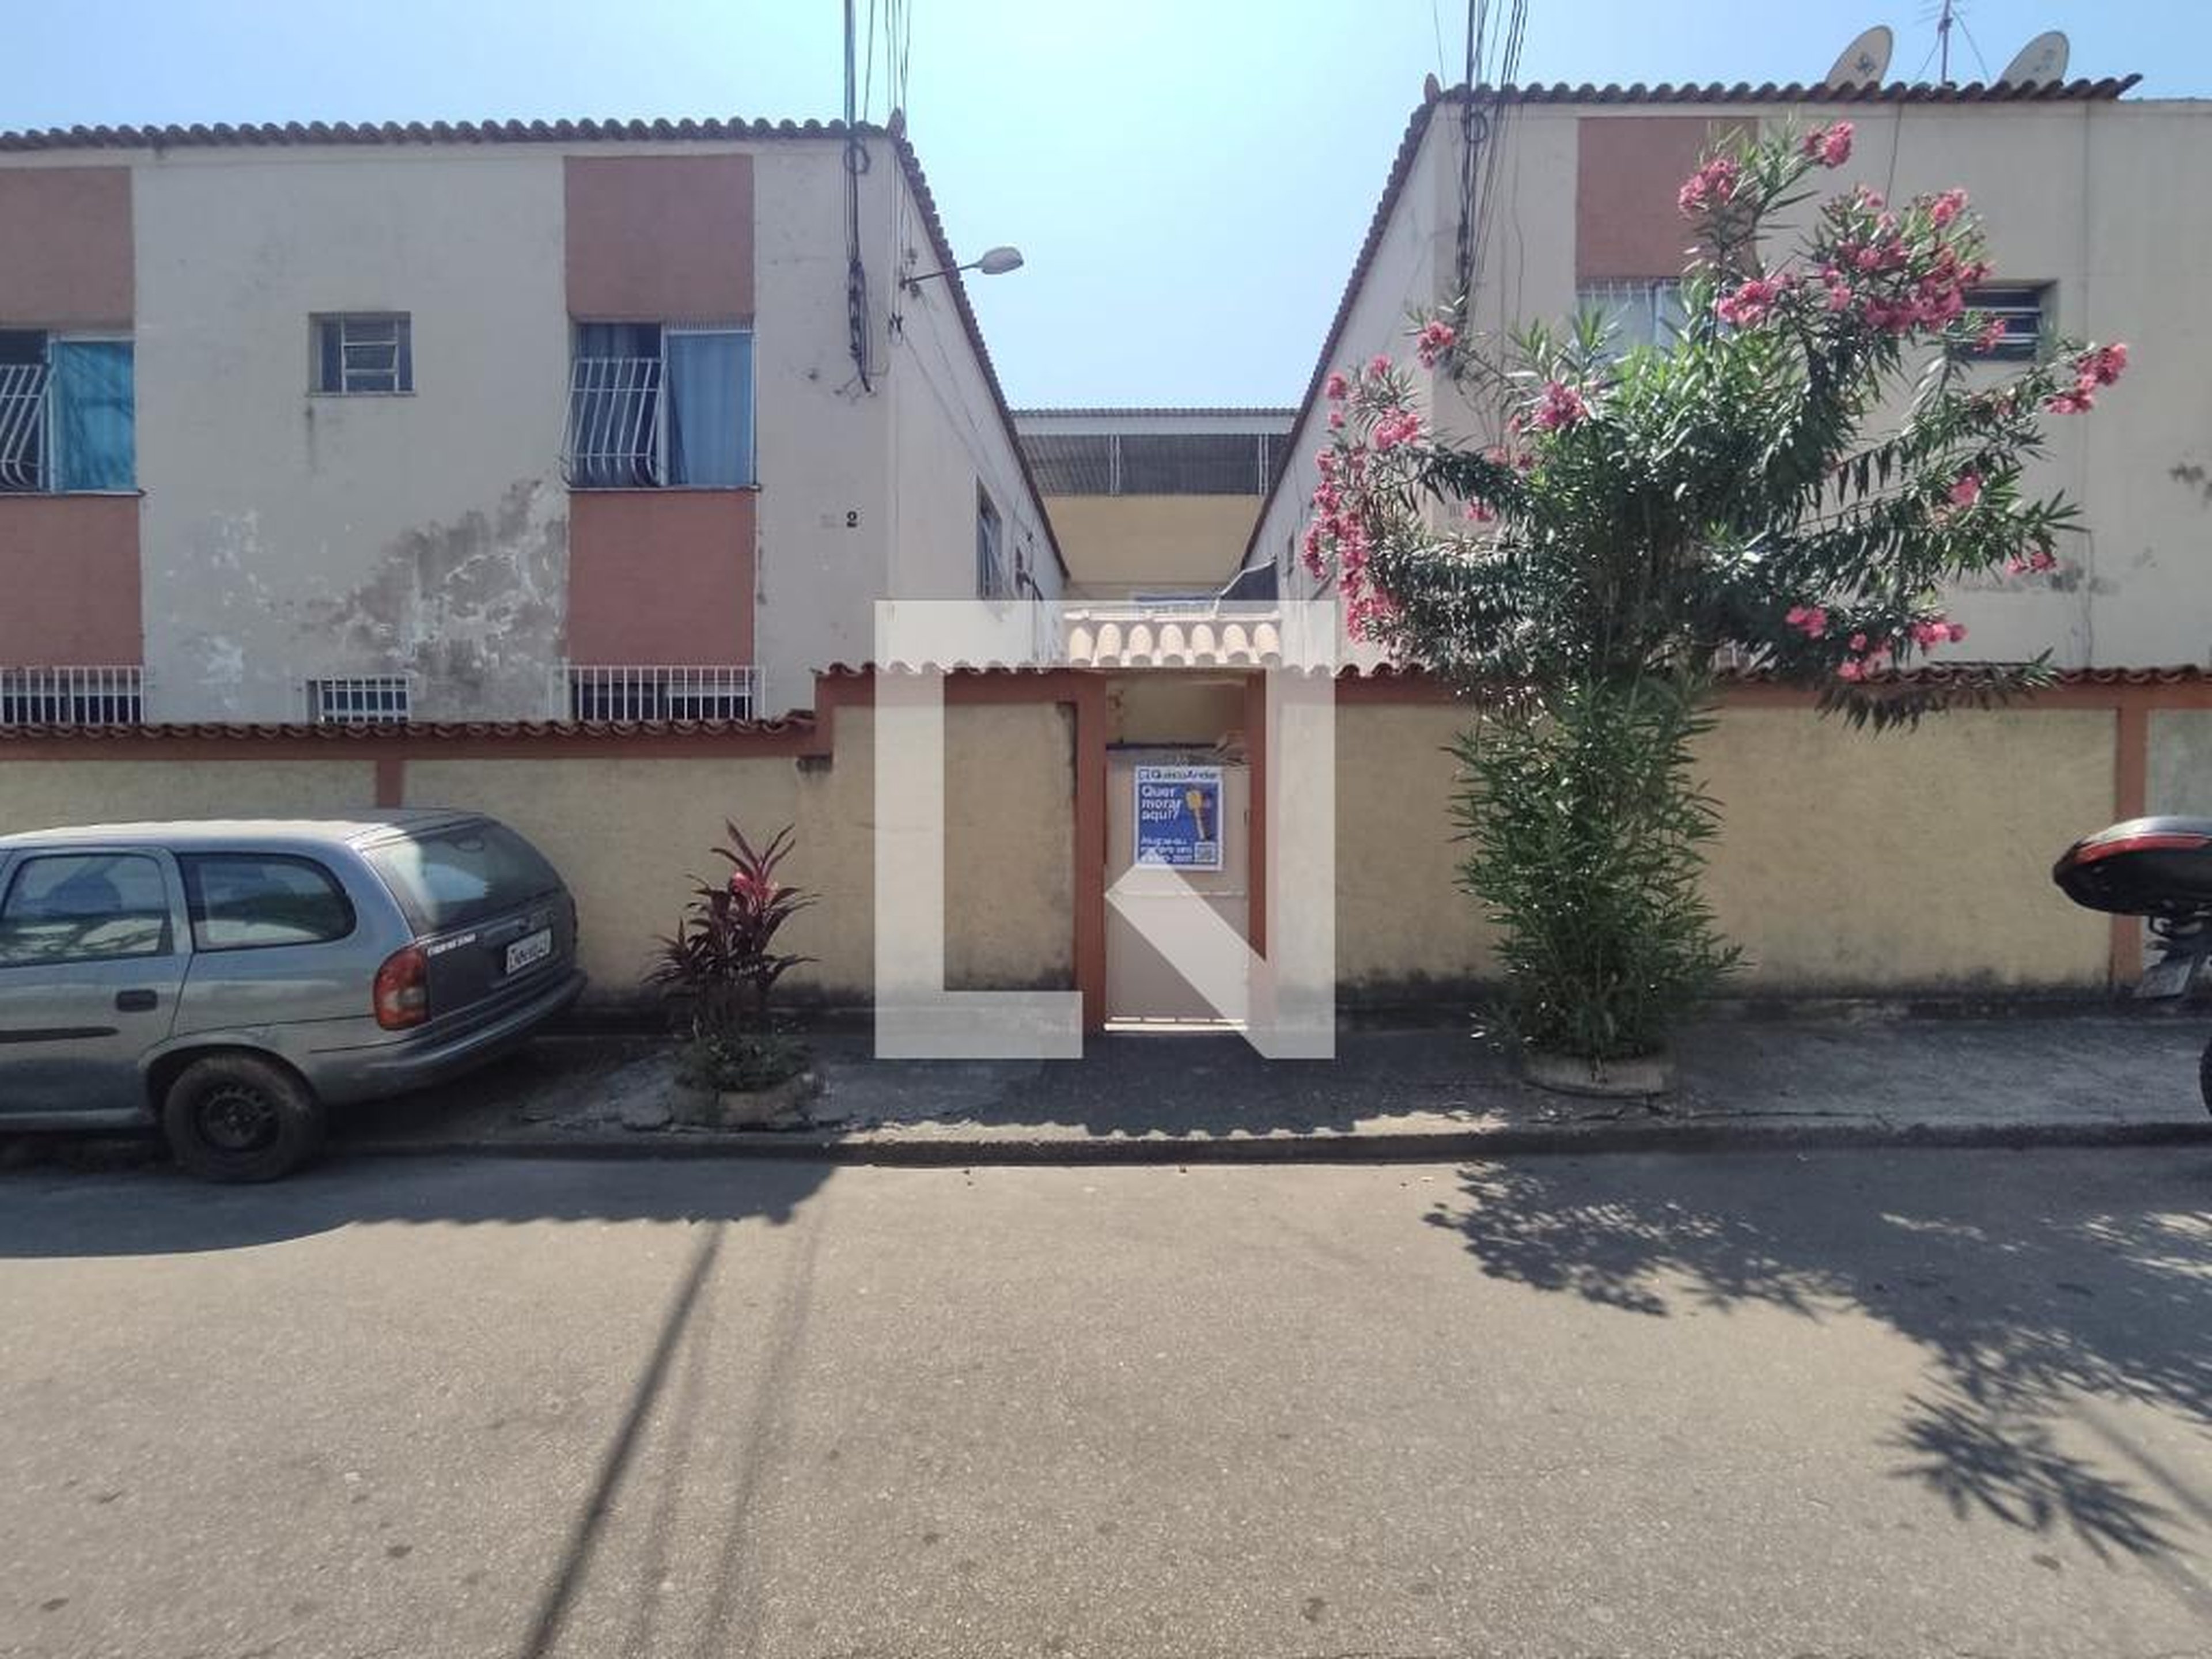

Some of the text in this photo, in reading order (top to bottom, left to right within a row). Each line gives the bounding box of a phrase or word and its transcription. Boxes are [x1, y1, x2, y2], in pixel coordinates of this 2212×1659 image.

[846, 510, 858, 528] 2
[1142, 785, 1176, 797] Quer
[1142, 798, 1181, 809] morar
